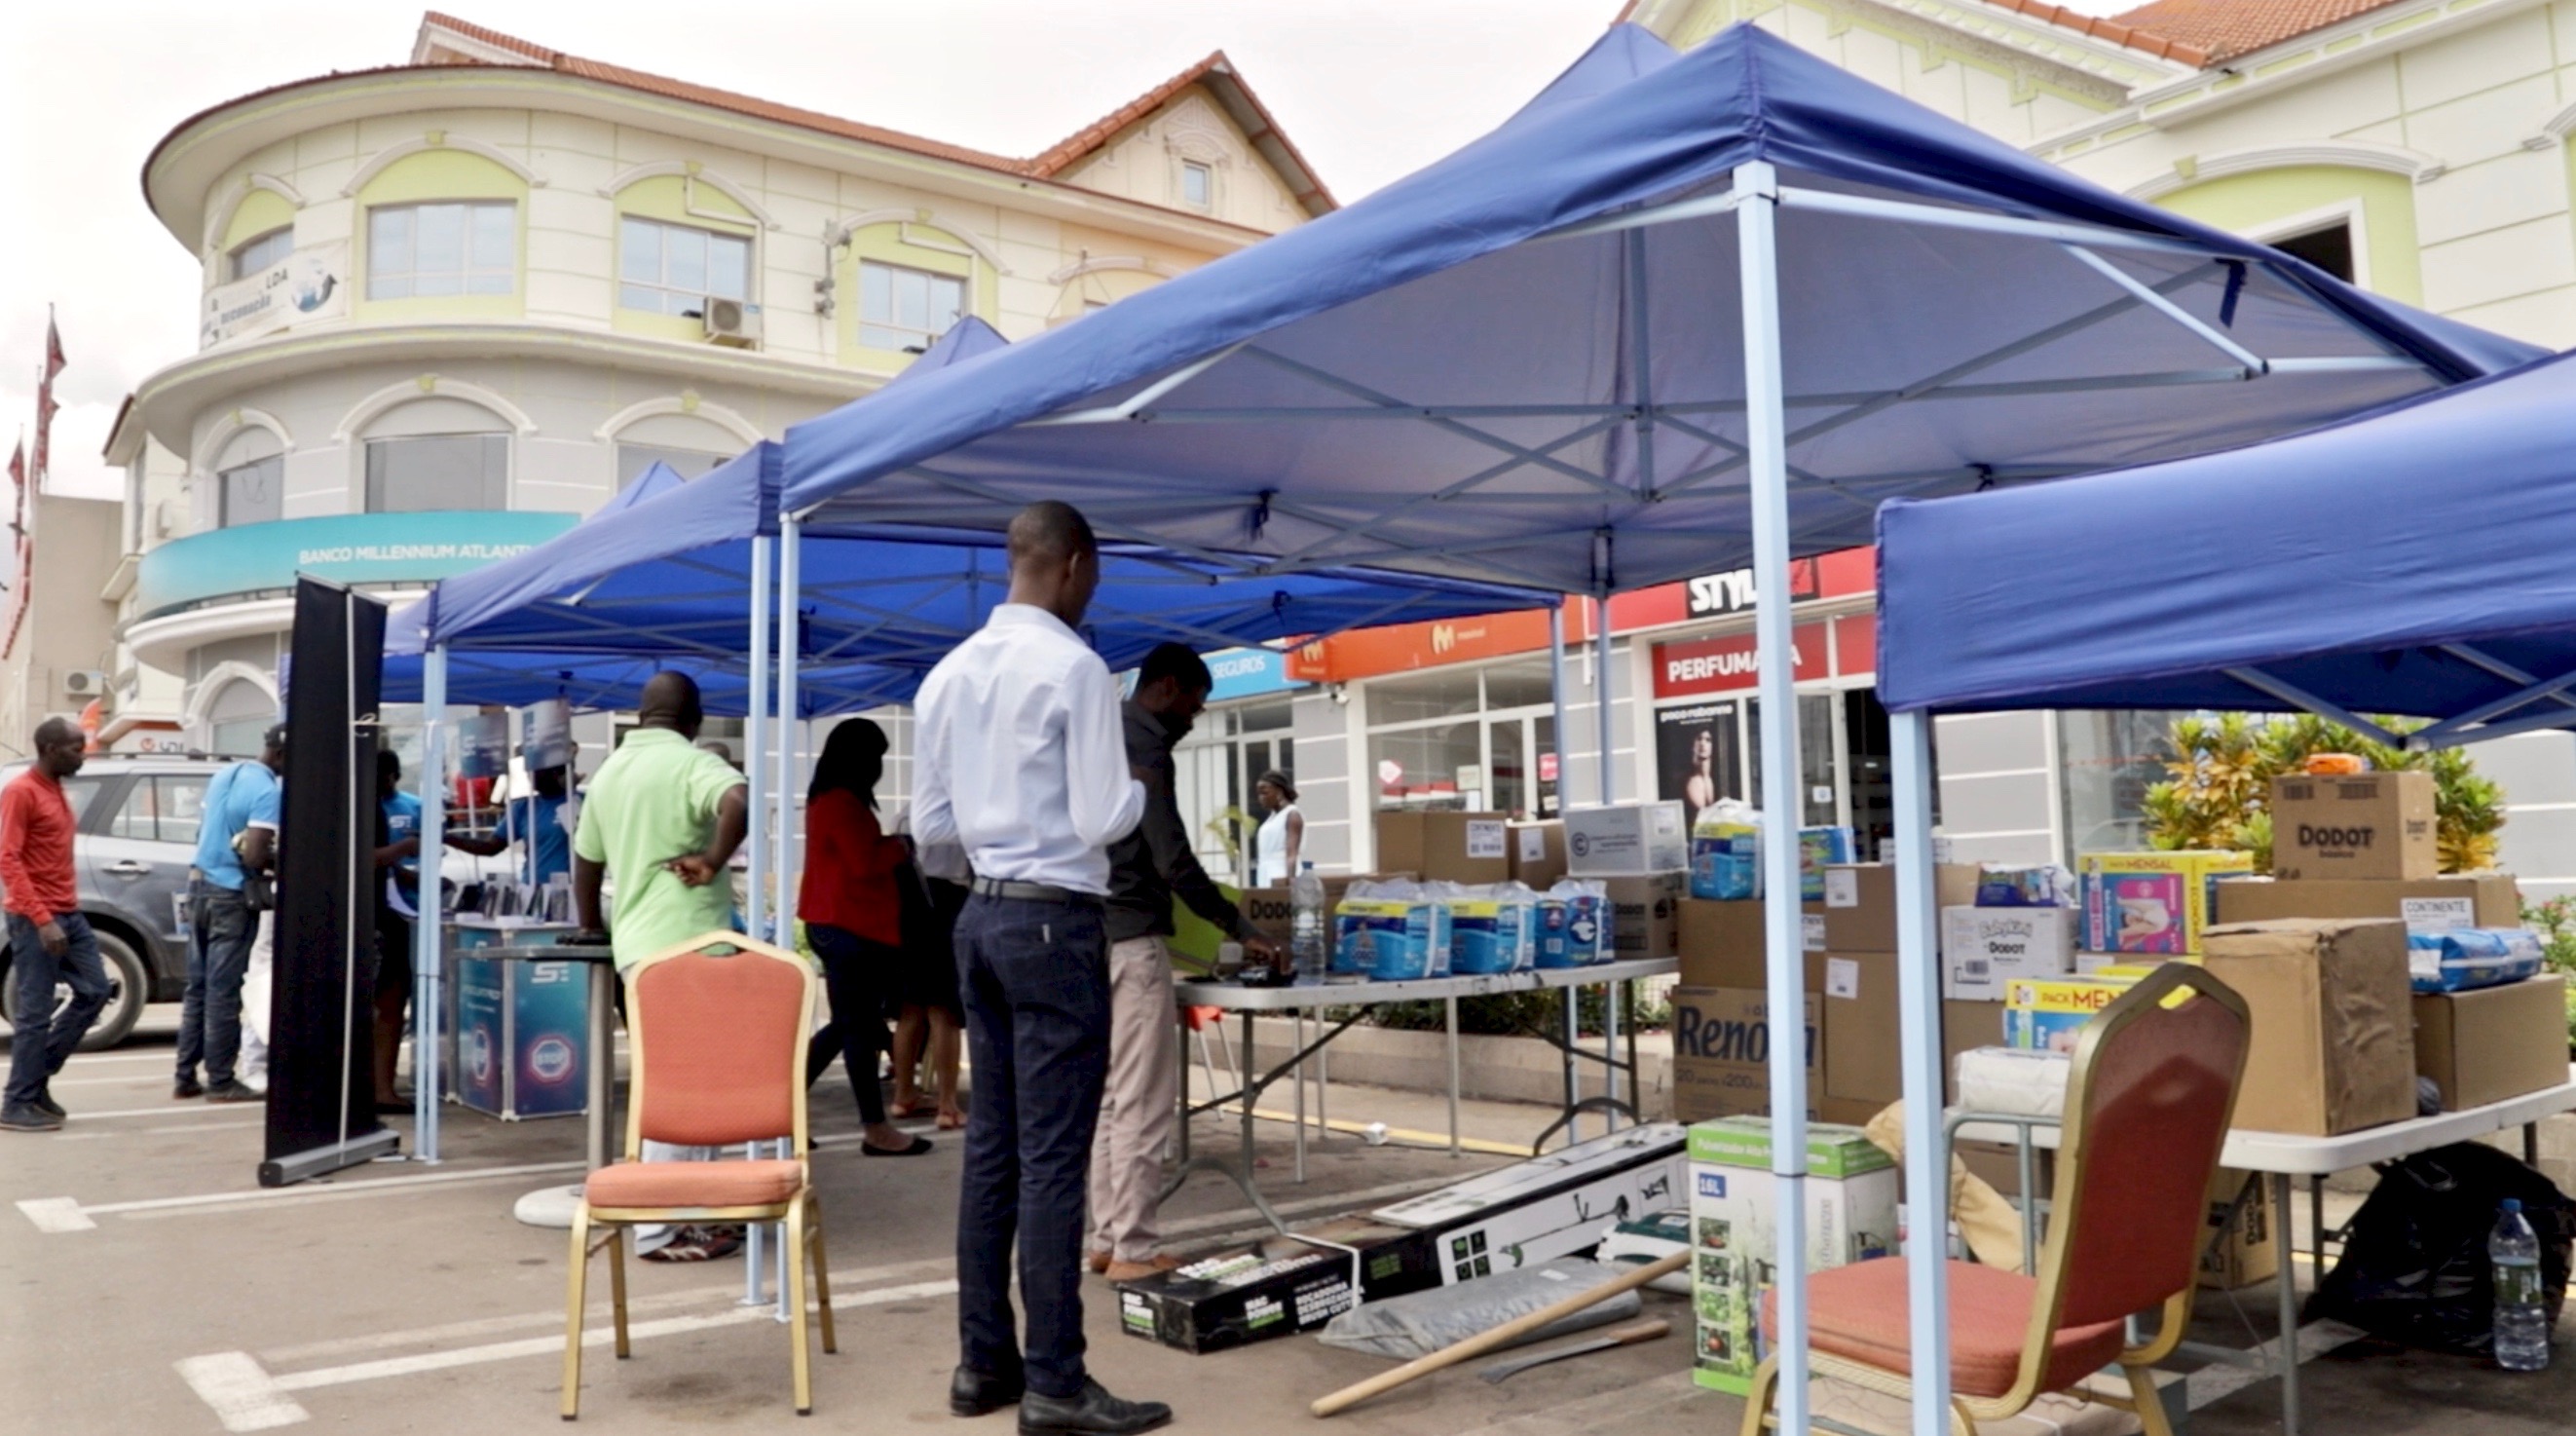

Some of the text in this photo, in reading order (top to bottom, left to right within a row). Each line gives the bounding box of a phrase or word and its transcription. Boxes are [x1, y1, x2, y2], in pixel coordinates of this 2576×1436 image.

[299, 547, 352, 564] BANCO
[355, 545, 455, 560] MILLENNIUM
[1690, 568, 1758, 612] STYL
[1213, 655, 1265, 680] SEGUROS
[1668, 644, 1802, 682] PERFUMAA
[2297, 824, 2373, 849] DODOT
[2126, 858, 2173, 870] MENSAL
[2407, 900, 2467, 914] CONTINENTE
[1989, 941, 2026, 955] DODOT
[2072, 989, 2121, 1010] MEN
[1699, 1177, 1721, 1195] 16L
